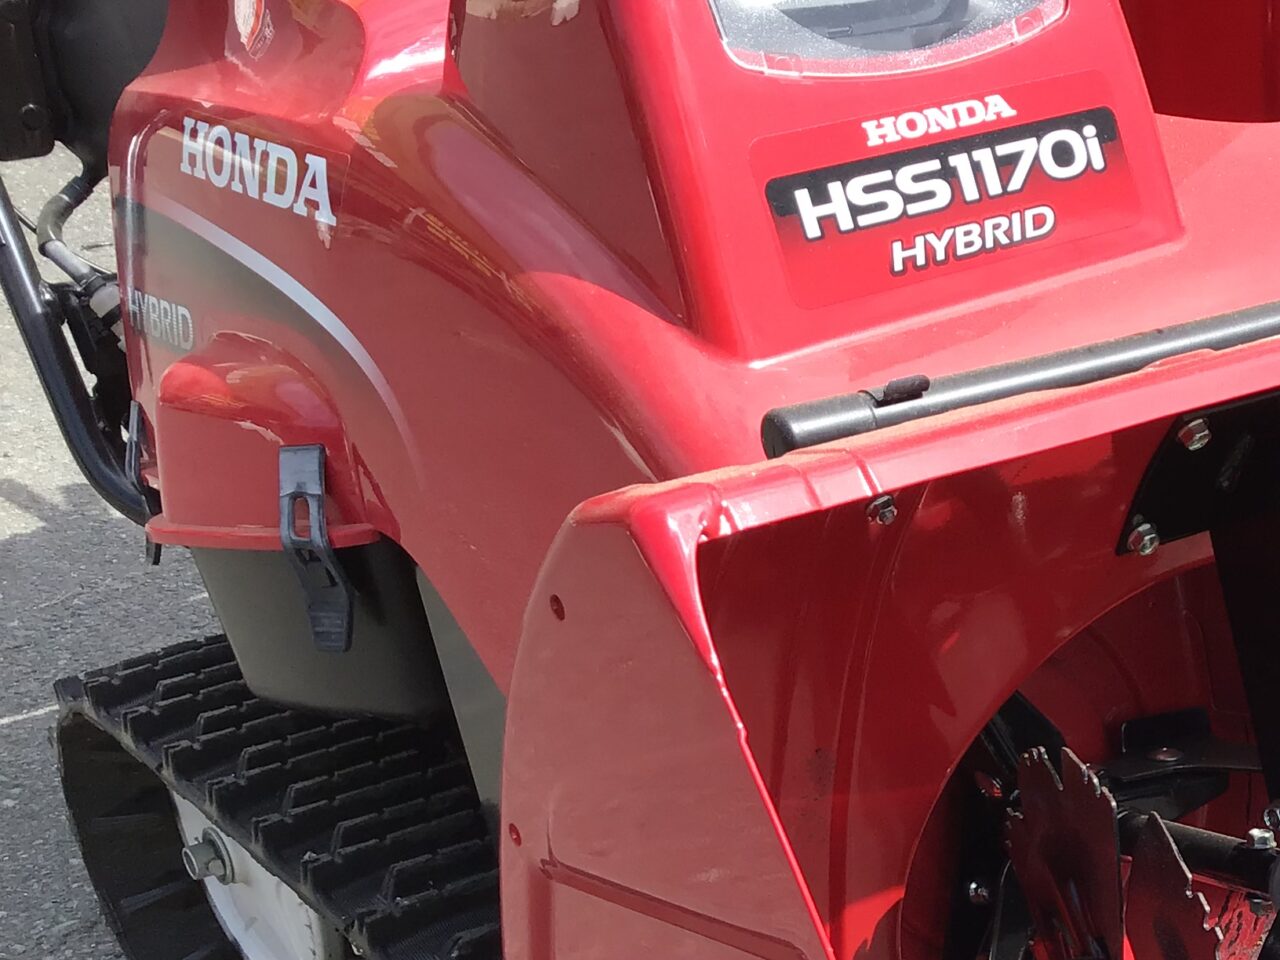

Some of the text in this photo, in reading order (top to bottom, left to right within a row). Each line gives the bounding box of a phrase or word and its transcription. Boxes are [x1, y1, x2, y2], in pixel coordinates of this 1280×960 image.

[862, 94, 1016, 147] HONDA
[180, 117, 337, 226] HONDA
[793, 124, 1106, 239] HSS1170i
[892, 205, 1056, 273] HYBRID
[127, 287, 194, 351] HYBRID
